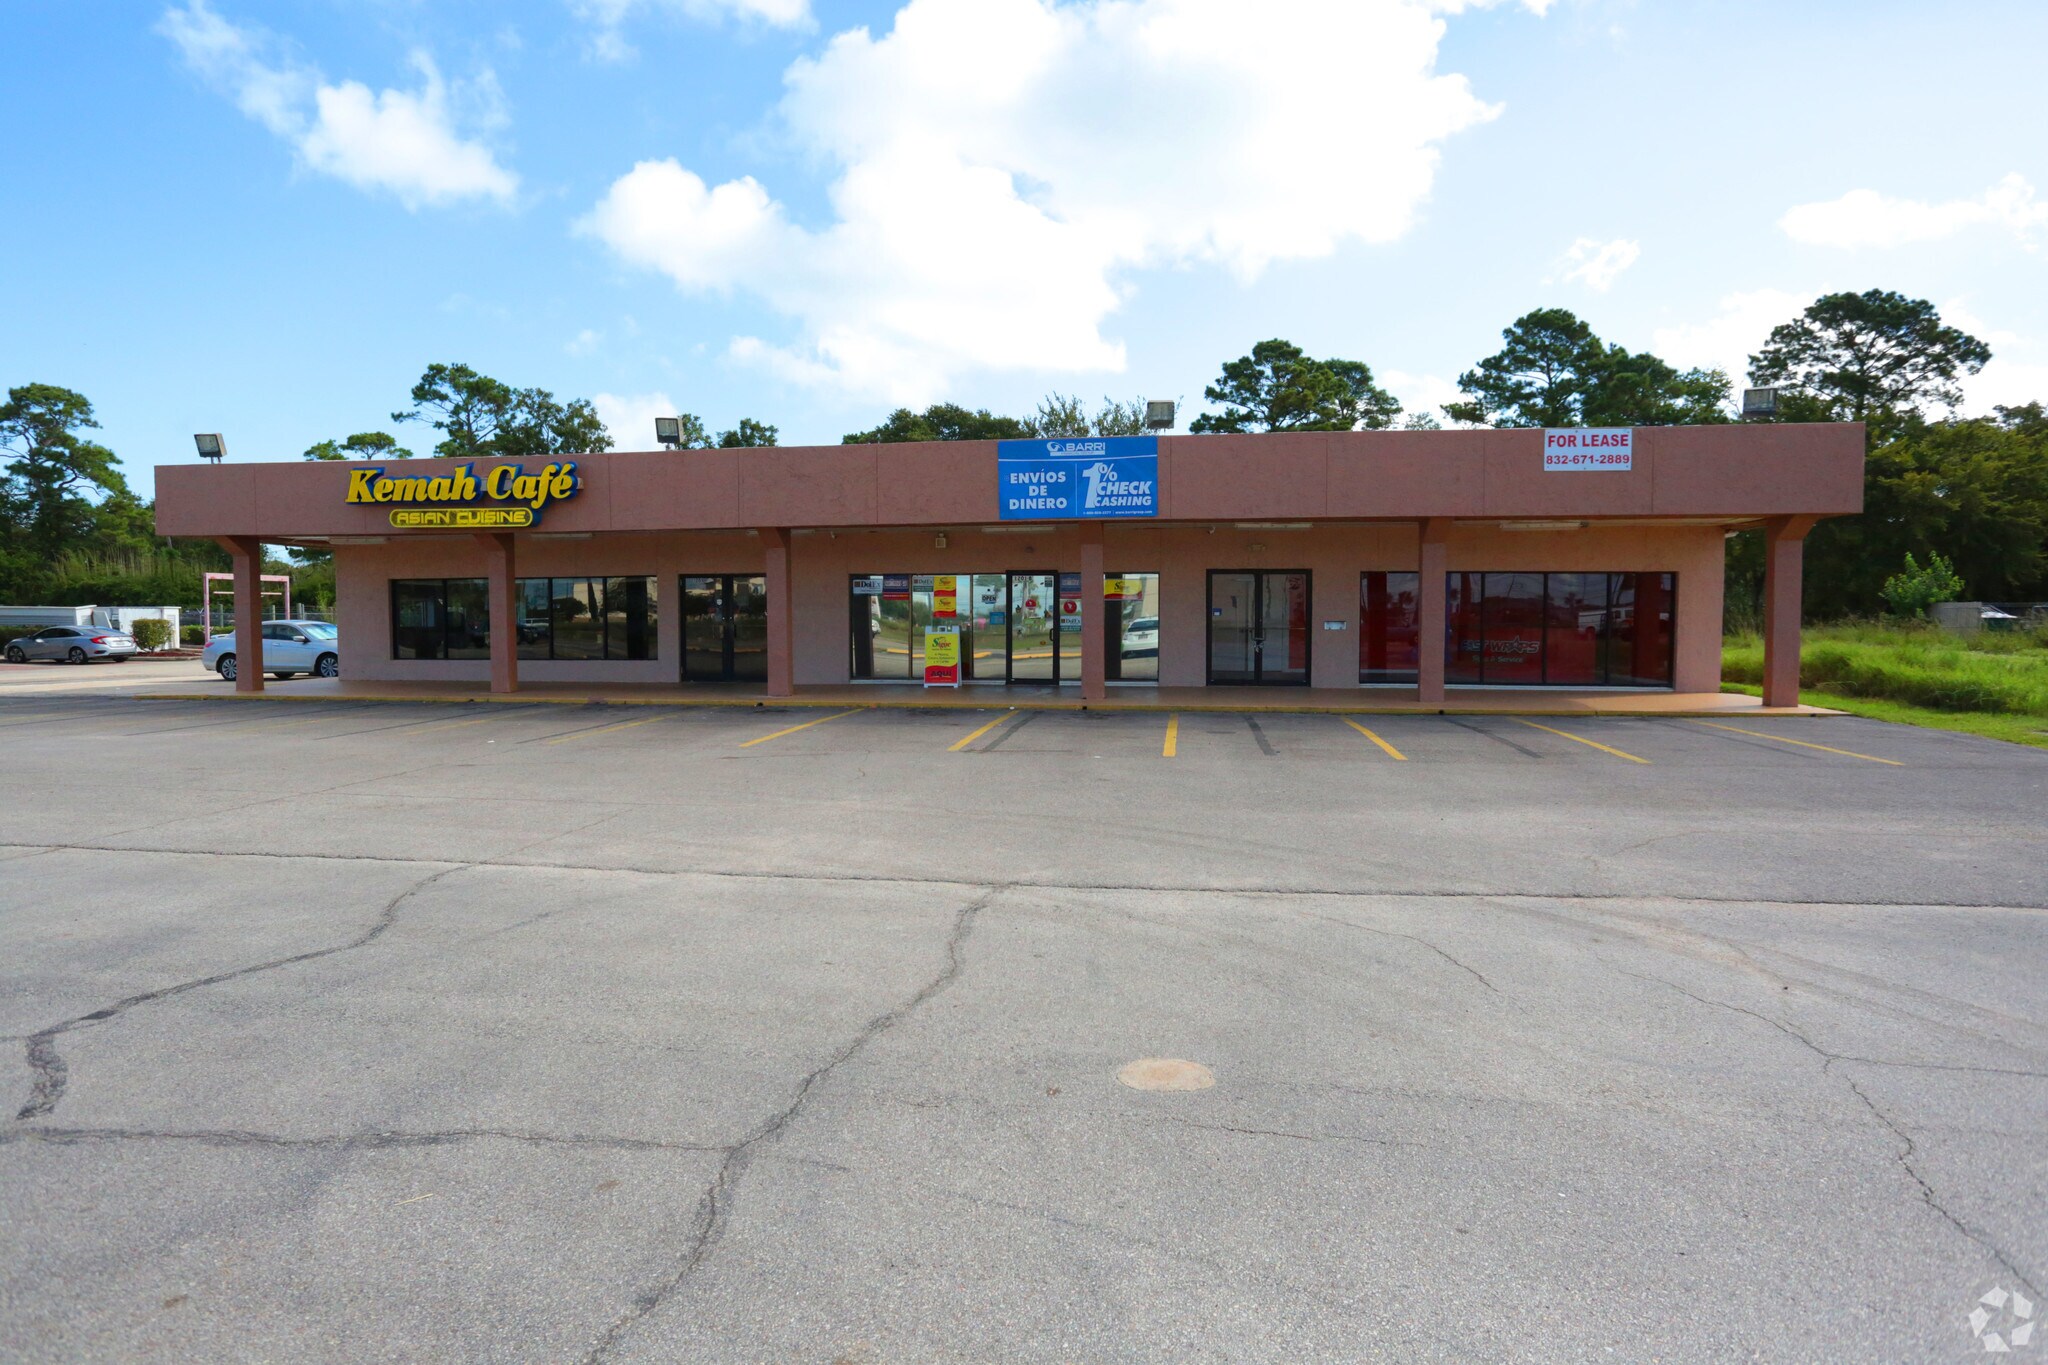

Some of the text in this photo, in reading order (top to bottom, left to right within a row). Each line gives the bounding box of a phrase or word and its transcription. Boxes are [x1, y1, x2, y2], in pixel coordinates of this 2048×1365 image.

[1066, 442, 1105, 451] BARRI
[1547, 434, 1629, 447] FOR LEASE
[1546, 454, 1630, 464] 832-671-2889
[1010, 468, 1067, 484] ENVÍOS
[345, 460, 577, 509] Kemah Café
[1028, 485, 1048, 496] DE
[1096, 481, 1152, 496] CHECK
[1009, 497, 1068, 510] DINERO
[1094, 496, 1152, 507] CASHING
[396, 509, 526, 525] ASIAN CUISINE
